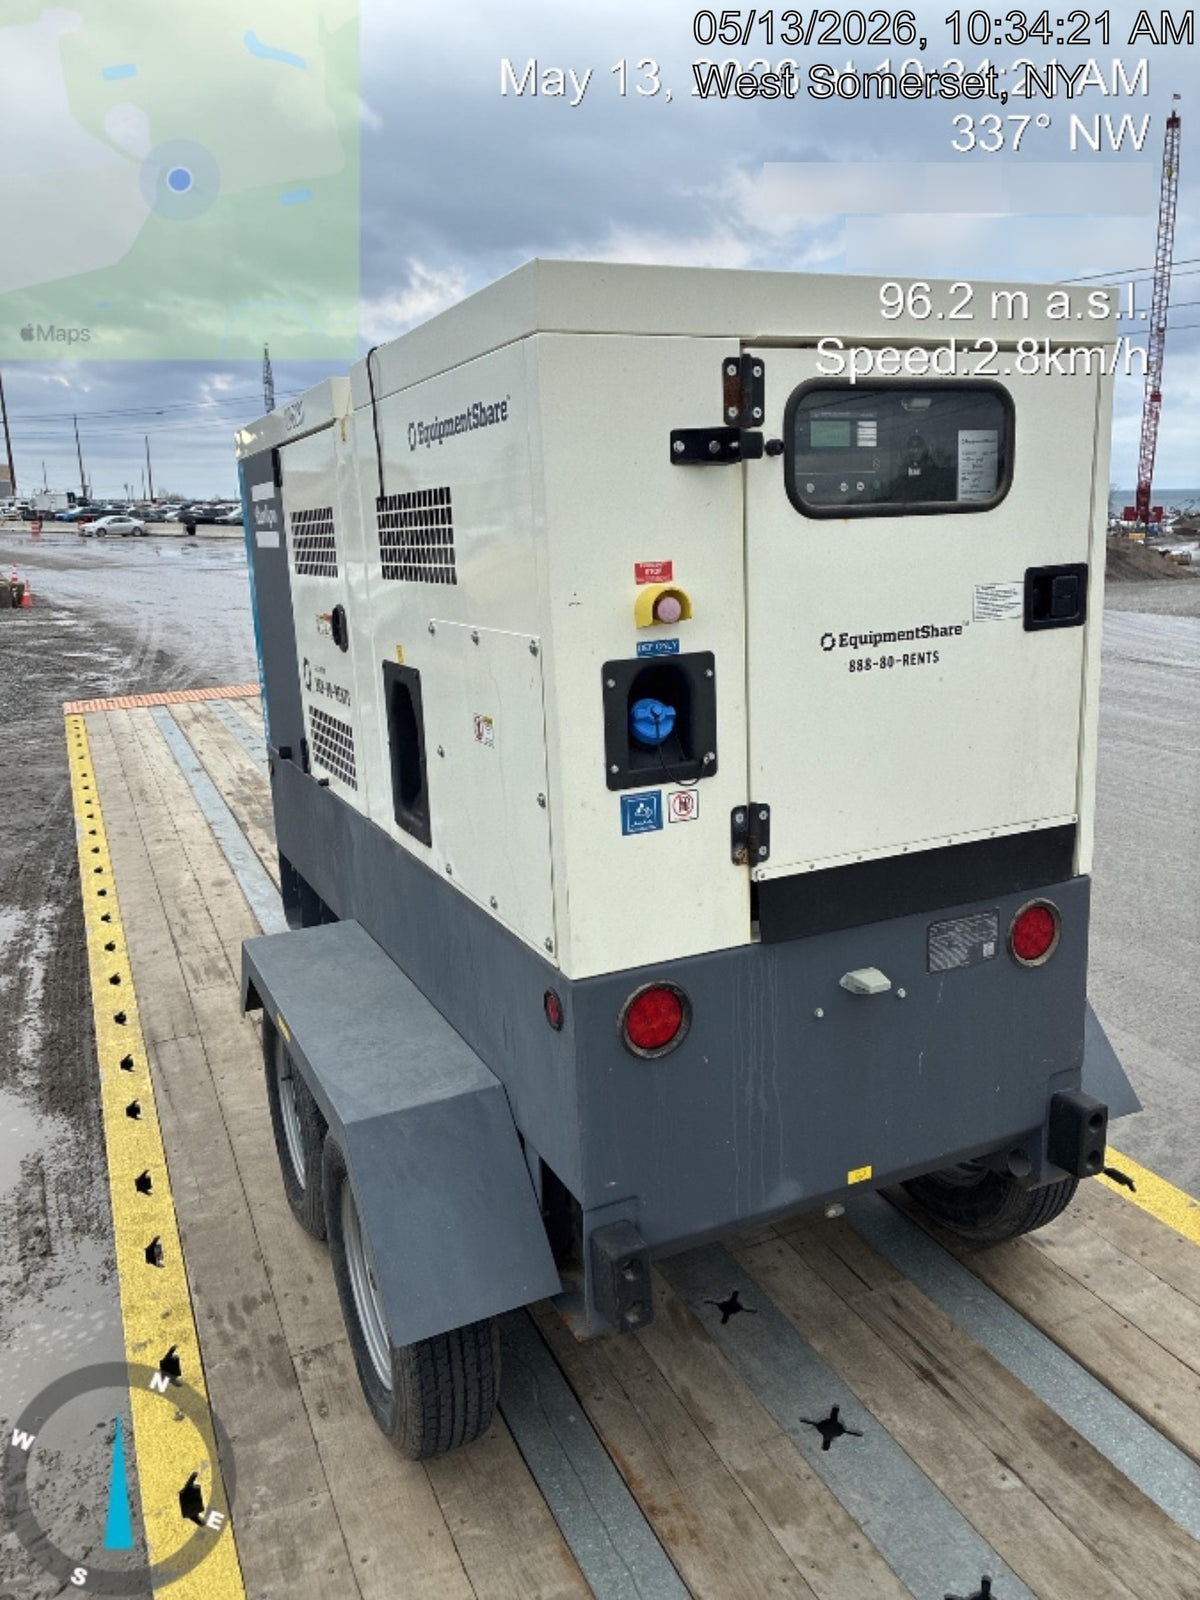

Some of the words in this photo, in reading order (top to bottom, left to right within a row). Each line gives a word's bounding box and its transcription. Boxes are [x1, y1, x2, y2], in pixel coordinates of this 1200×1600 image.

[418, 400, 508, 448] EquipmentShare
[839, 623, 963, 650] EquipmentShare
[849, 650, 940, 673] 888-80-RENTS
